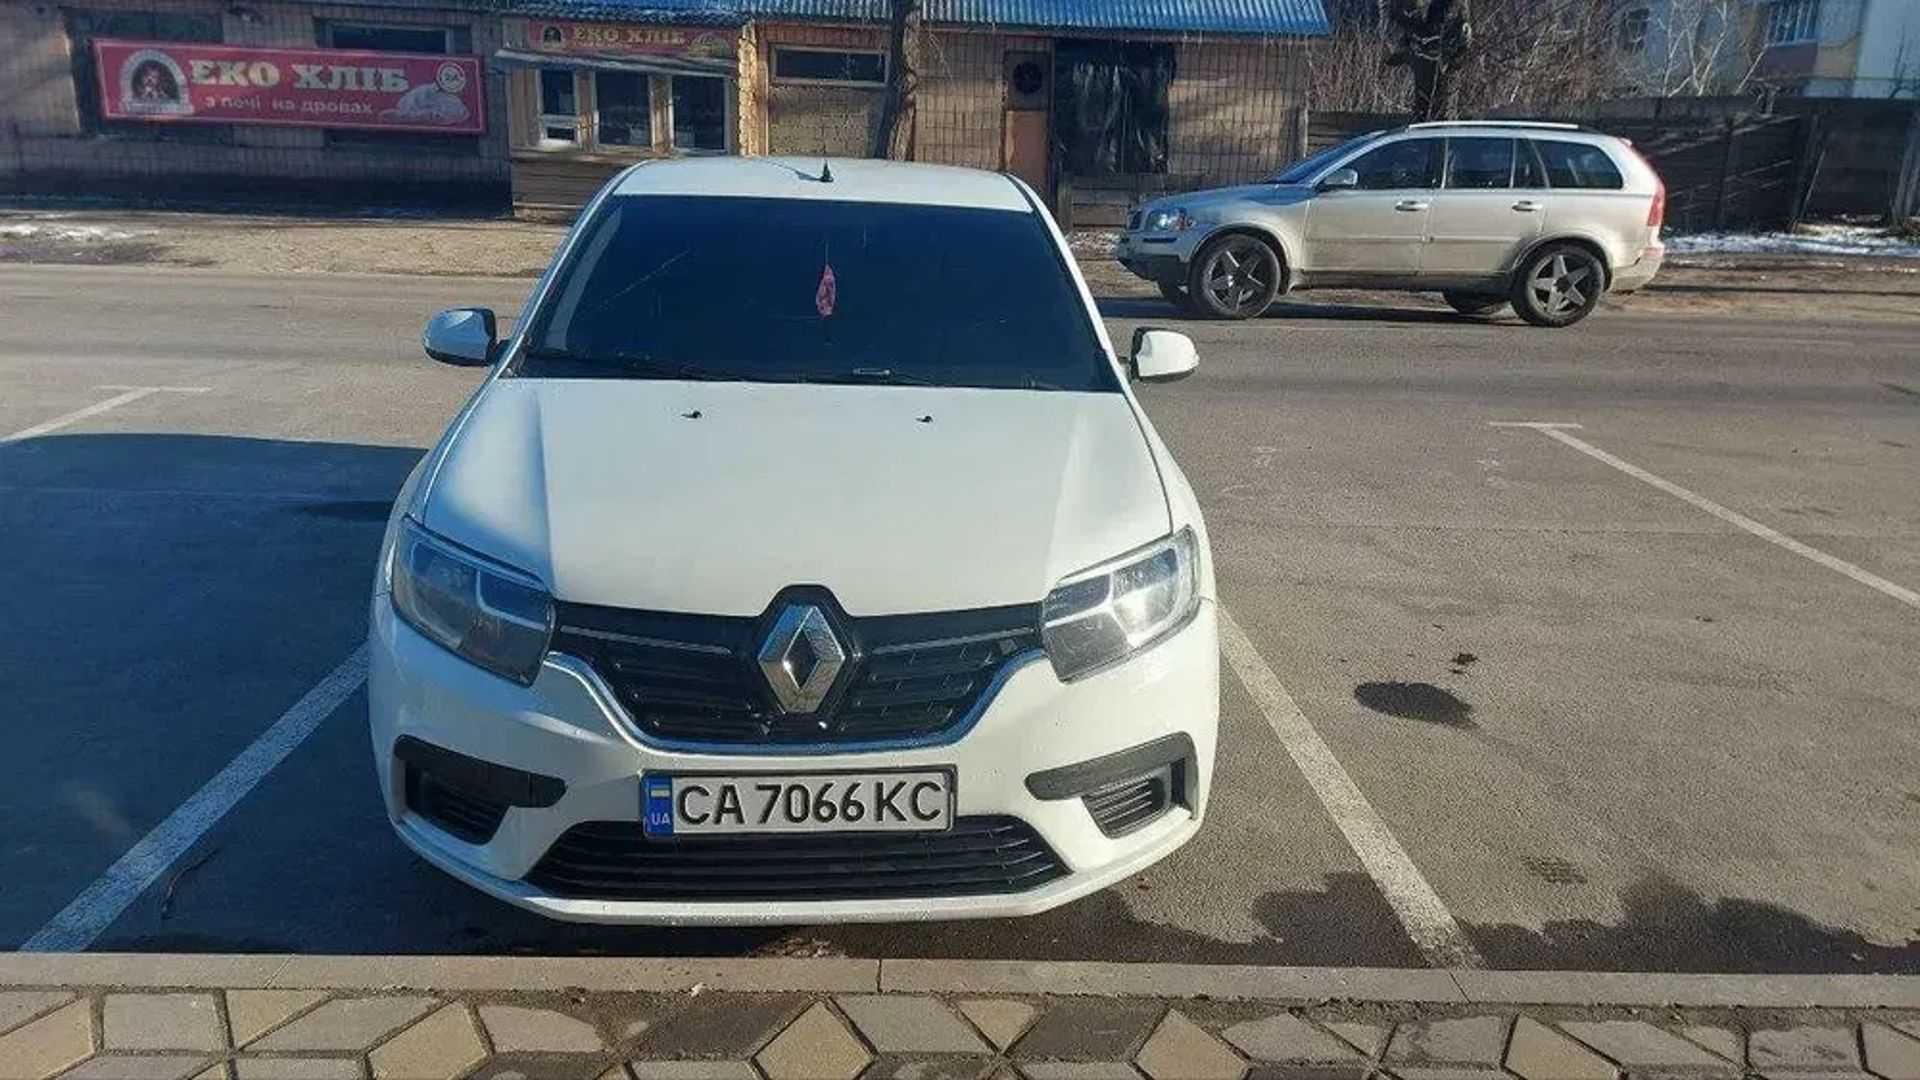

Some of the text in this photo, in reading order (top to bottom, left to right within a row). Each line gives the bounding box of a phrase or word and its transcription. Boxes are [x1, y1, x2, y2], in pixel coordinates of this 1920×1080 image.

[188, 60, 280, 87] ЕКО
[292, 65, 410, 93] ХЛІБ
[272, 98, 295, 111] на
[302, 101, 373, 115] дровах
[677, 780, 942, 825] CA 7066 KC
[651, 813, 671, 826] UA
